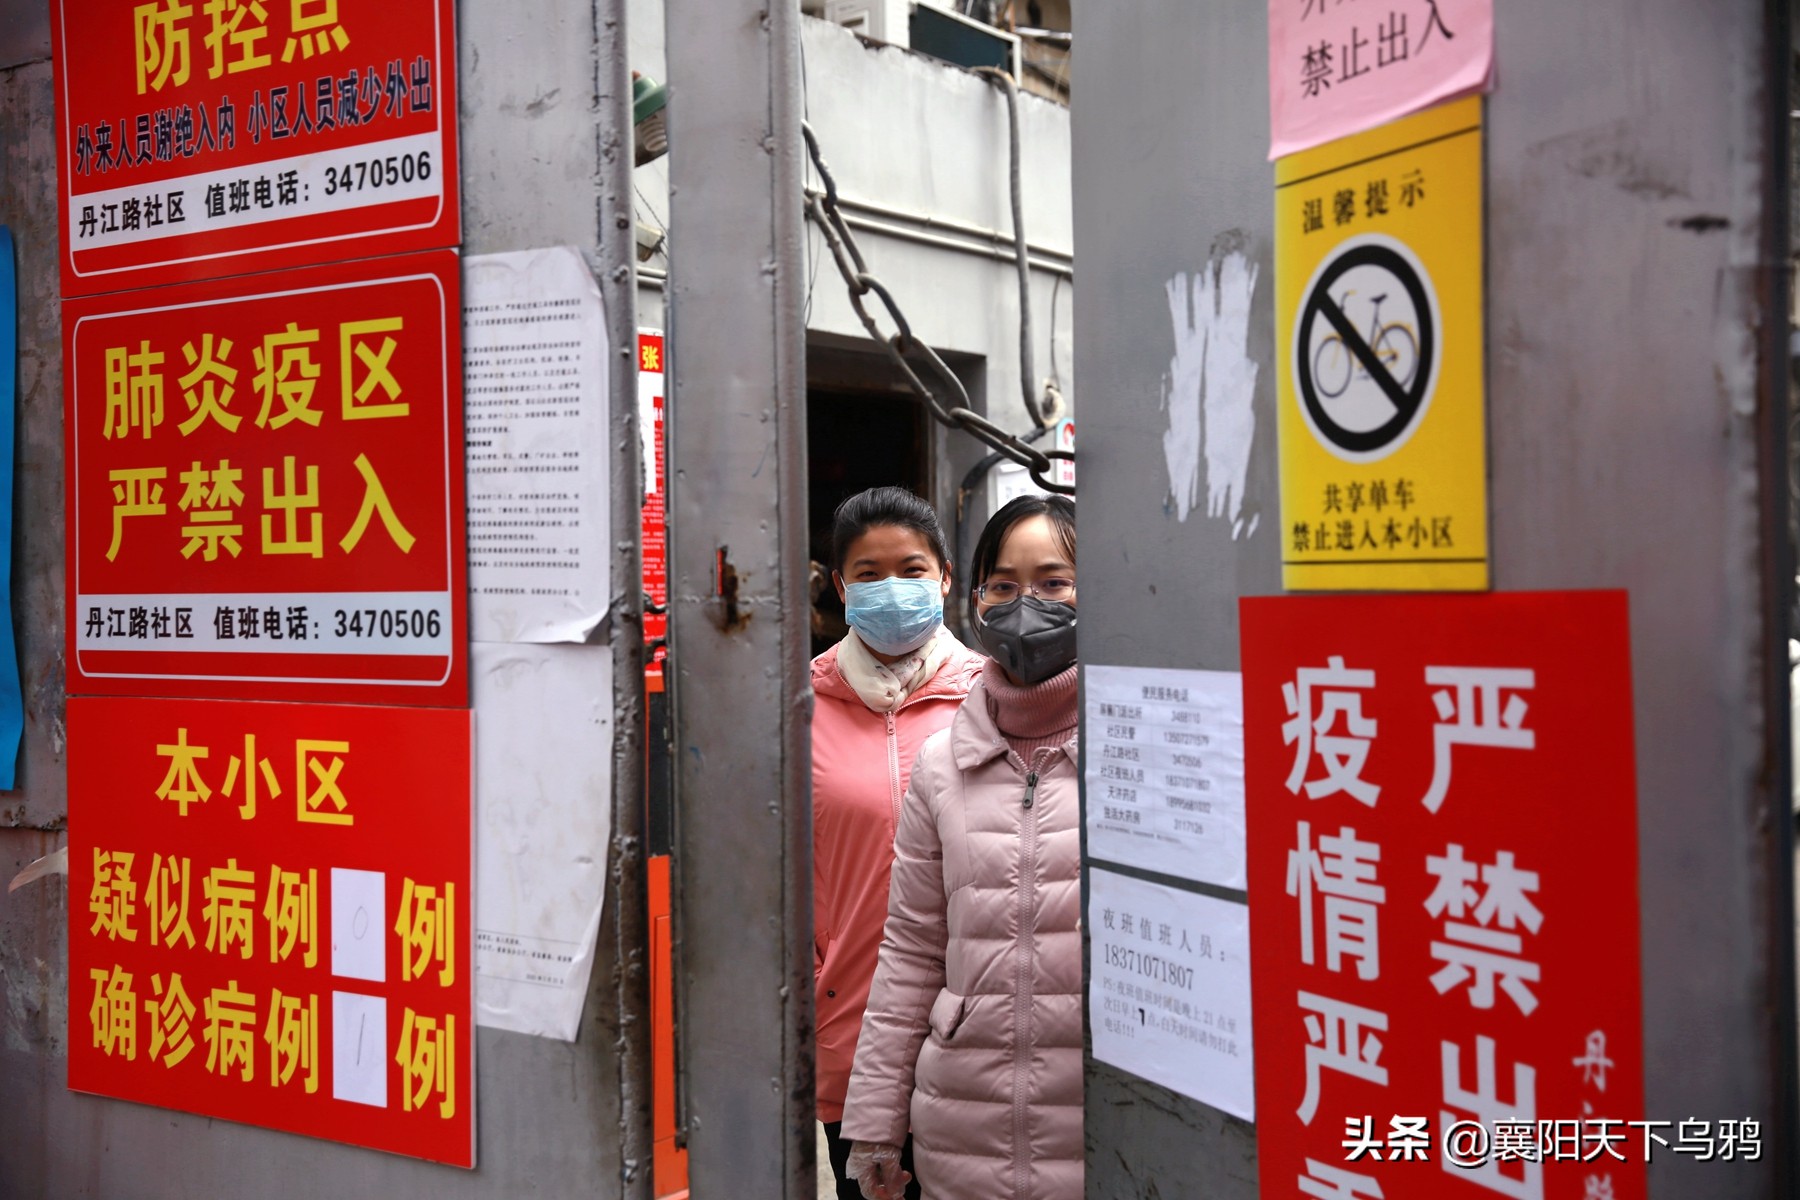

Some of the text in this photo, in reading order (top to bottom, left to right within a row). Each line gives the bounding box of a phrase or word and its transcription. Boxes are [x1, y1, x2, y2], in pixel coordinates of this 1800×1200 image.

[133, 0, 351, 95] 防控点
[1301, 0, 1454, 99] 禁止出入
[75, 55, 432, 176] 外来人员谢绝入内 小区人员减少外出
[78, 190, 187, 238] 丹江路社区
[1302, 168, 1426, 235] 温馨提示
[102, 316, 410, 441] 肺炎疫区
[105, 452, 417, 563] 严禁出入
[1323, 477, 1415, 515] 共享单车
[85, 606, 195, 640] 丹江路社区
[154, 727, 354, 826] 本小区
[89, 847, 319, 969] 疑似病例
[394, 876, 456, 988] 例
[1102, 907, 1226, 962] 夜班值班人员：
[1104, 943, 1195, 992] 18371071807
[89, 964, 319, 1094] 确诊病例
[394, 1006, 456, 1120] 例
